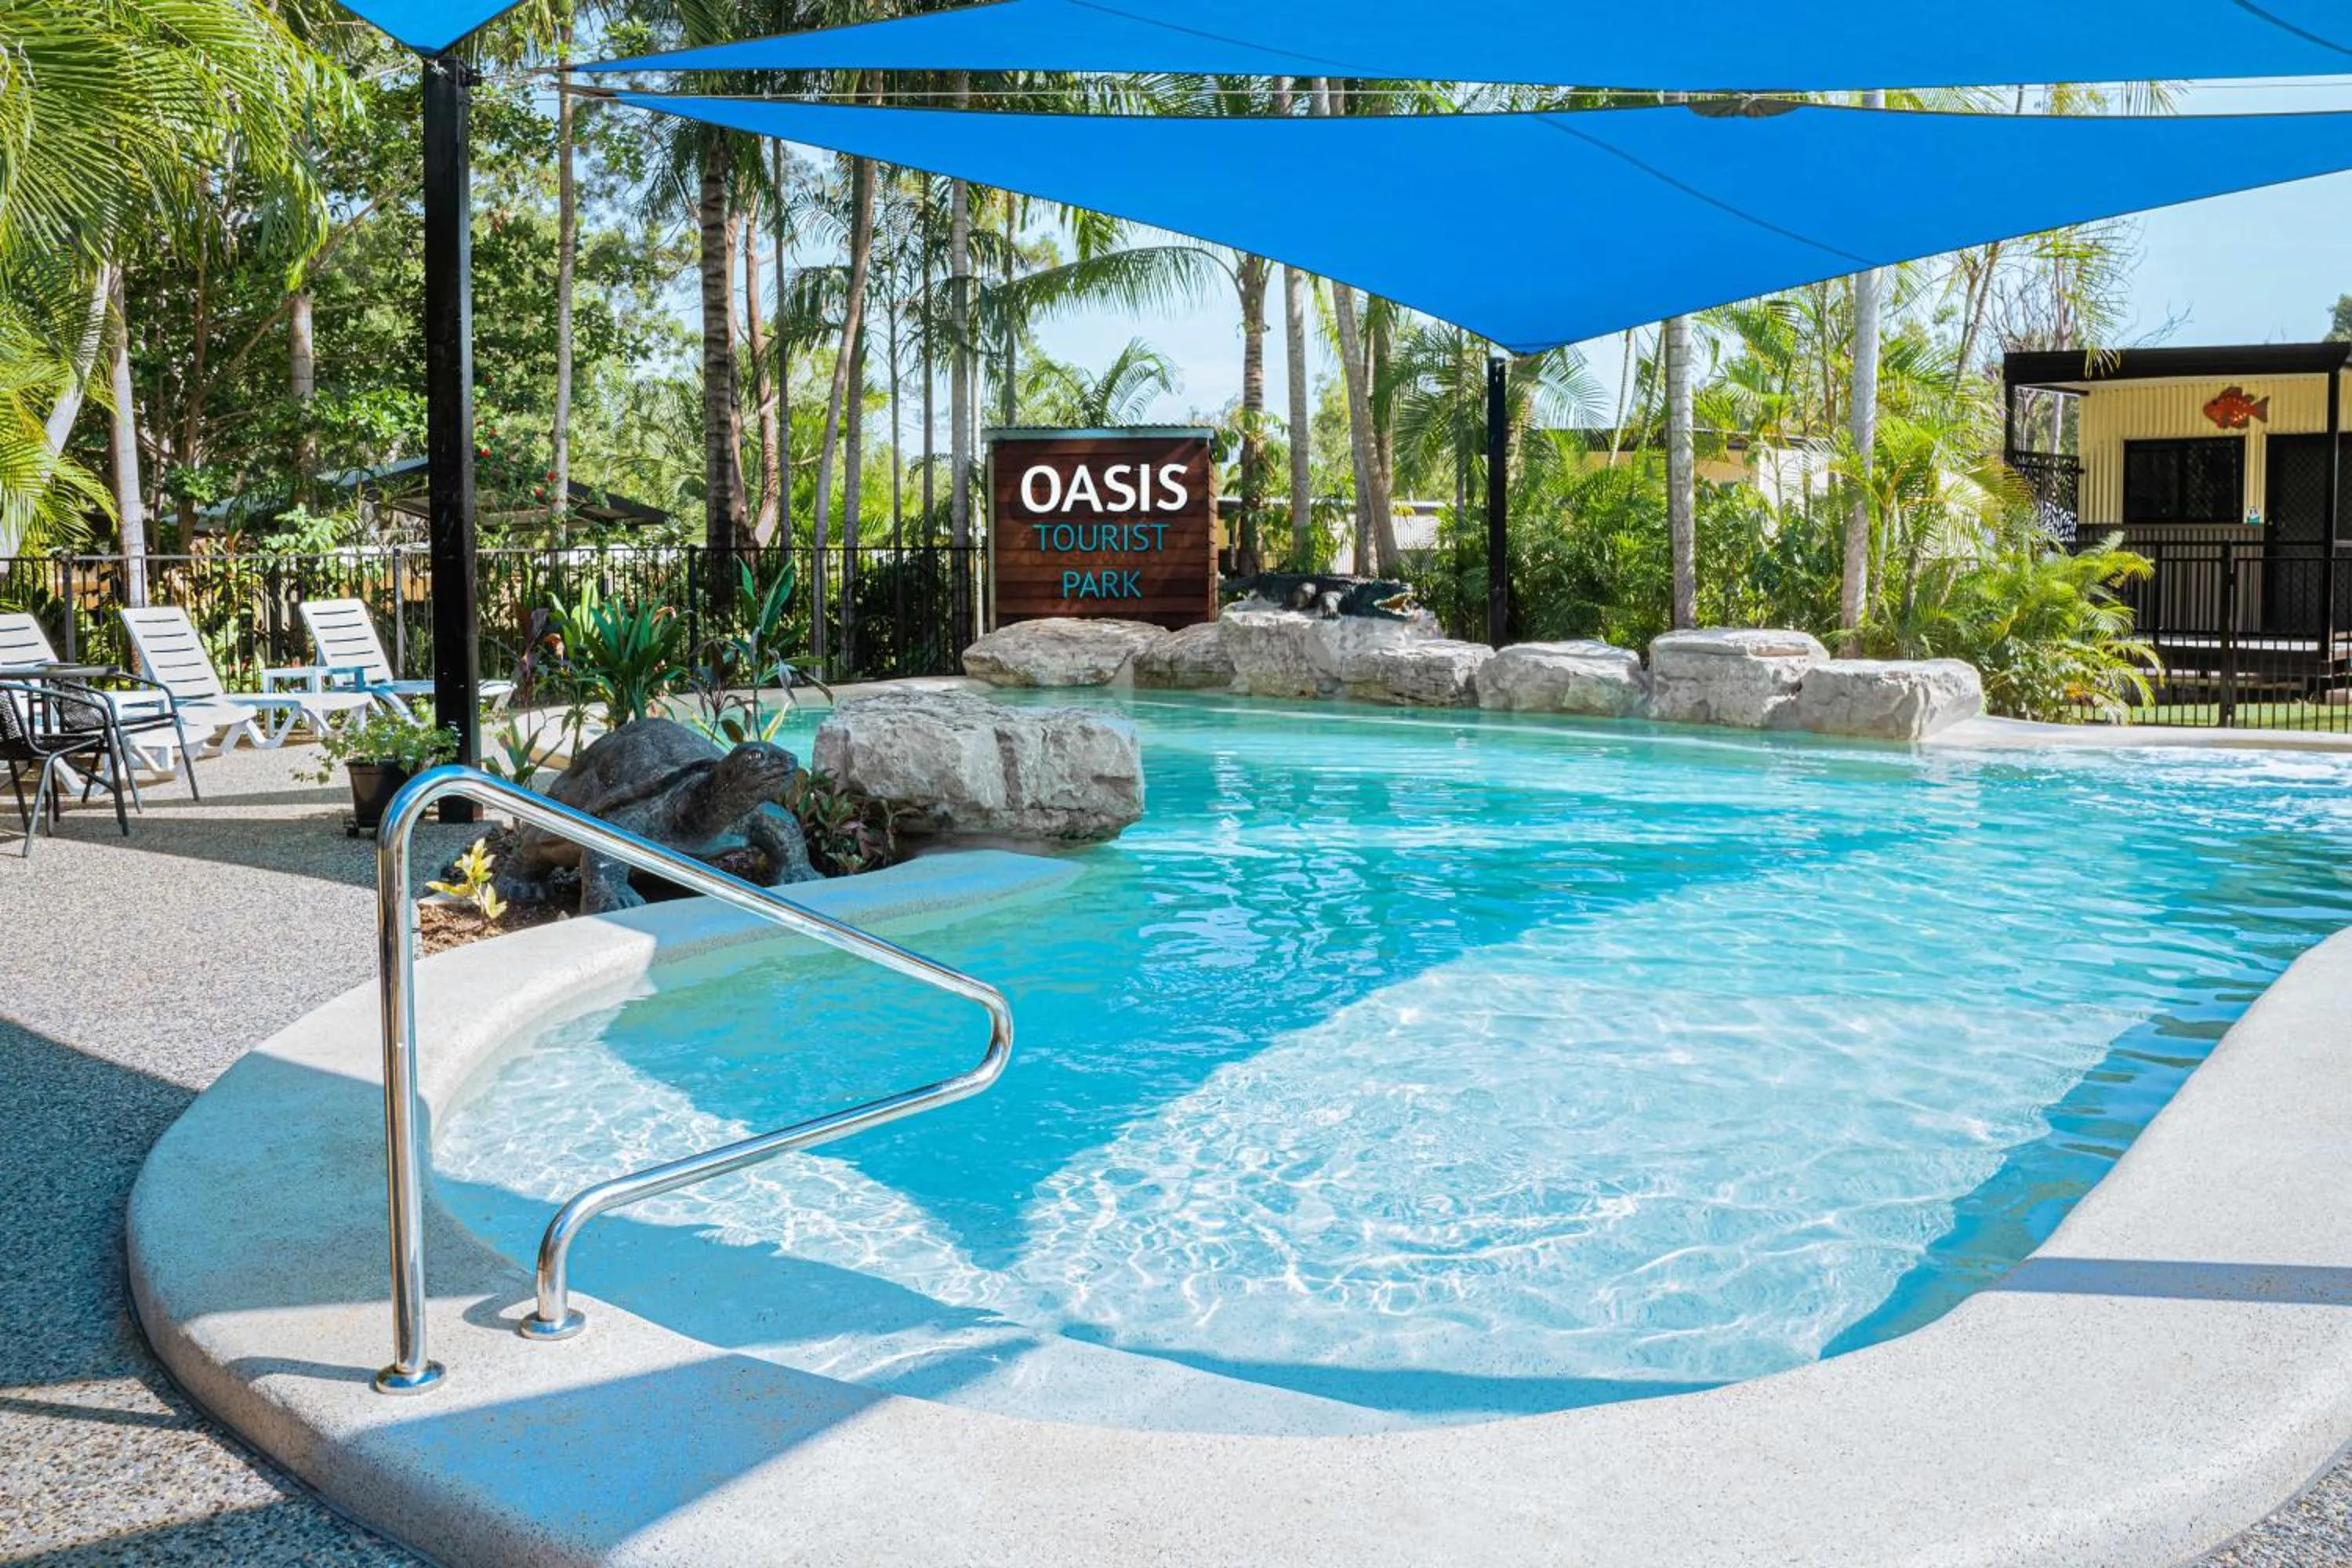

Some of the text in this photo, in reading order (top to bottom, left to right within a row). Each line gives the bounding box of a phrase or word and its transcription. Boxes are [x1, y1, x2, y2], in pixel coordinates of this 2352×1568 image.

[1020, 463, 1189, 513] OASIS
[1033, 523, 1170, 552] TOURIST
[1062, 570, 1142, 599] PARK
